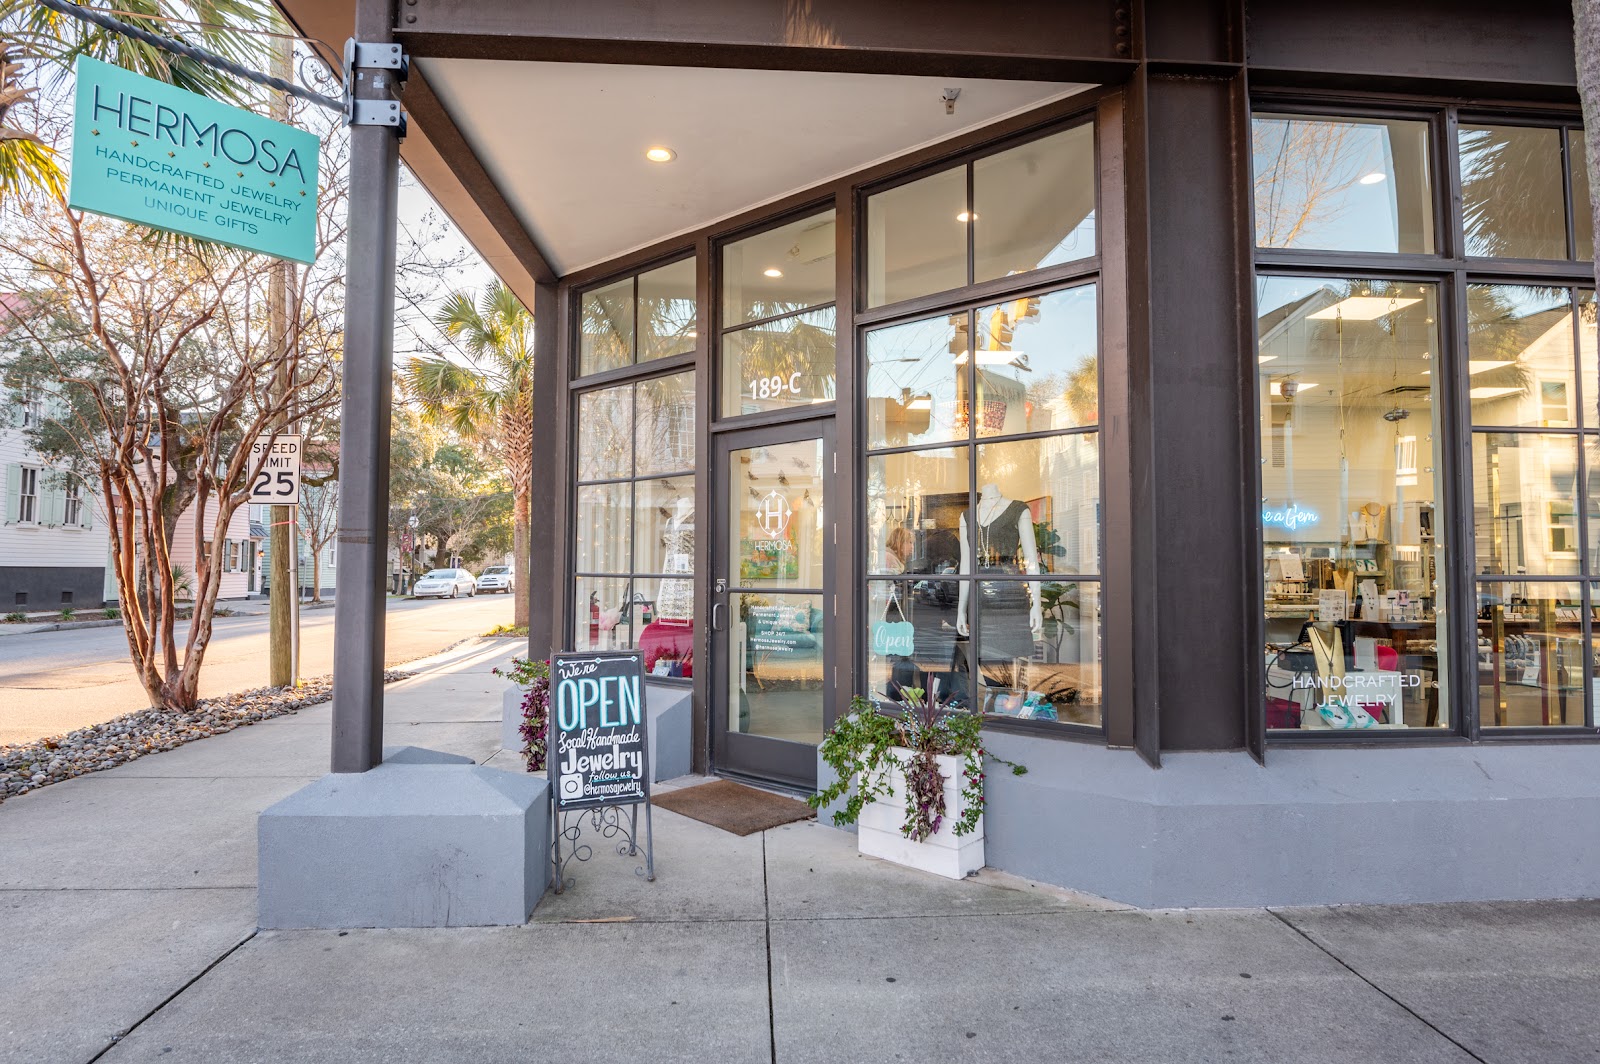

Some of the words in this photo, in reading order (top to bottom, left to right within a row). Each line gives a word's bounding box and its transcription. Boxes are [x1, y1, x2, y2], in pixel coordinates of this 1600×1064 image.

[93, 84, 305, 184] HERMOSA
[95, 145, 224, 190] HANDCRAFTED
[230, 185, 301, 212] JEWELRY
[106, 168, 215, 205] PERMANENT
[219, 200, 291, 226] JEWELRY
[144, 196, 208, 222] UNIQUE
[214, 215, 258, 235] GIFTS
[749, 372, 801, 400] 189-C
[253, 471, 294, 496] 25
[1273, 512, 1285, 522] a
[1285, 504, 1318, 530] Gem
[754, 540, 793, 551] HERMOSA
[875, 625, 911, 653] Open
[558, 663, 598, 680] We're
[1292, 674, 1421, 689] HANDCRAFTED
[557, 675, 641, 732] OPEN
[1316, 694, 1397, 708] JEWELRY
[558, 729, 587, 754] Local
[586, 725, 641, 750] Handmade
[560, 744, 643, 780] Jewelry
[584, 780, 641, 796] @hermosajewelry
[588, 770, 618, 783] follow
[619, 770, 632, 779] us
